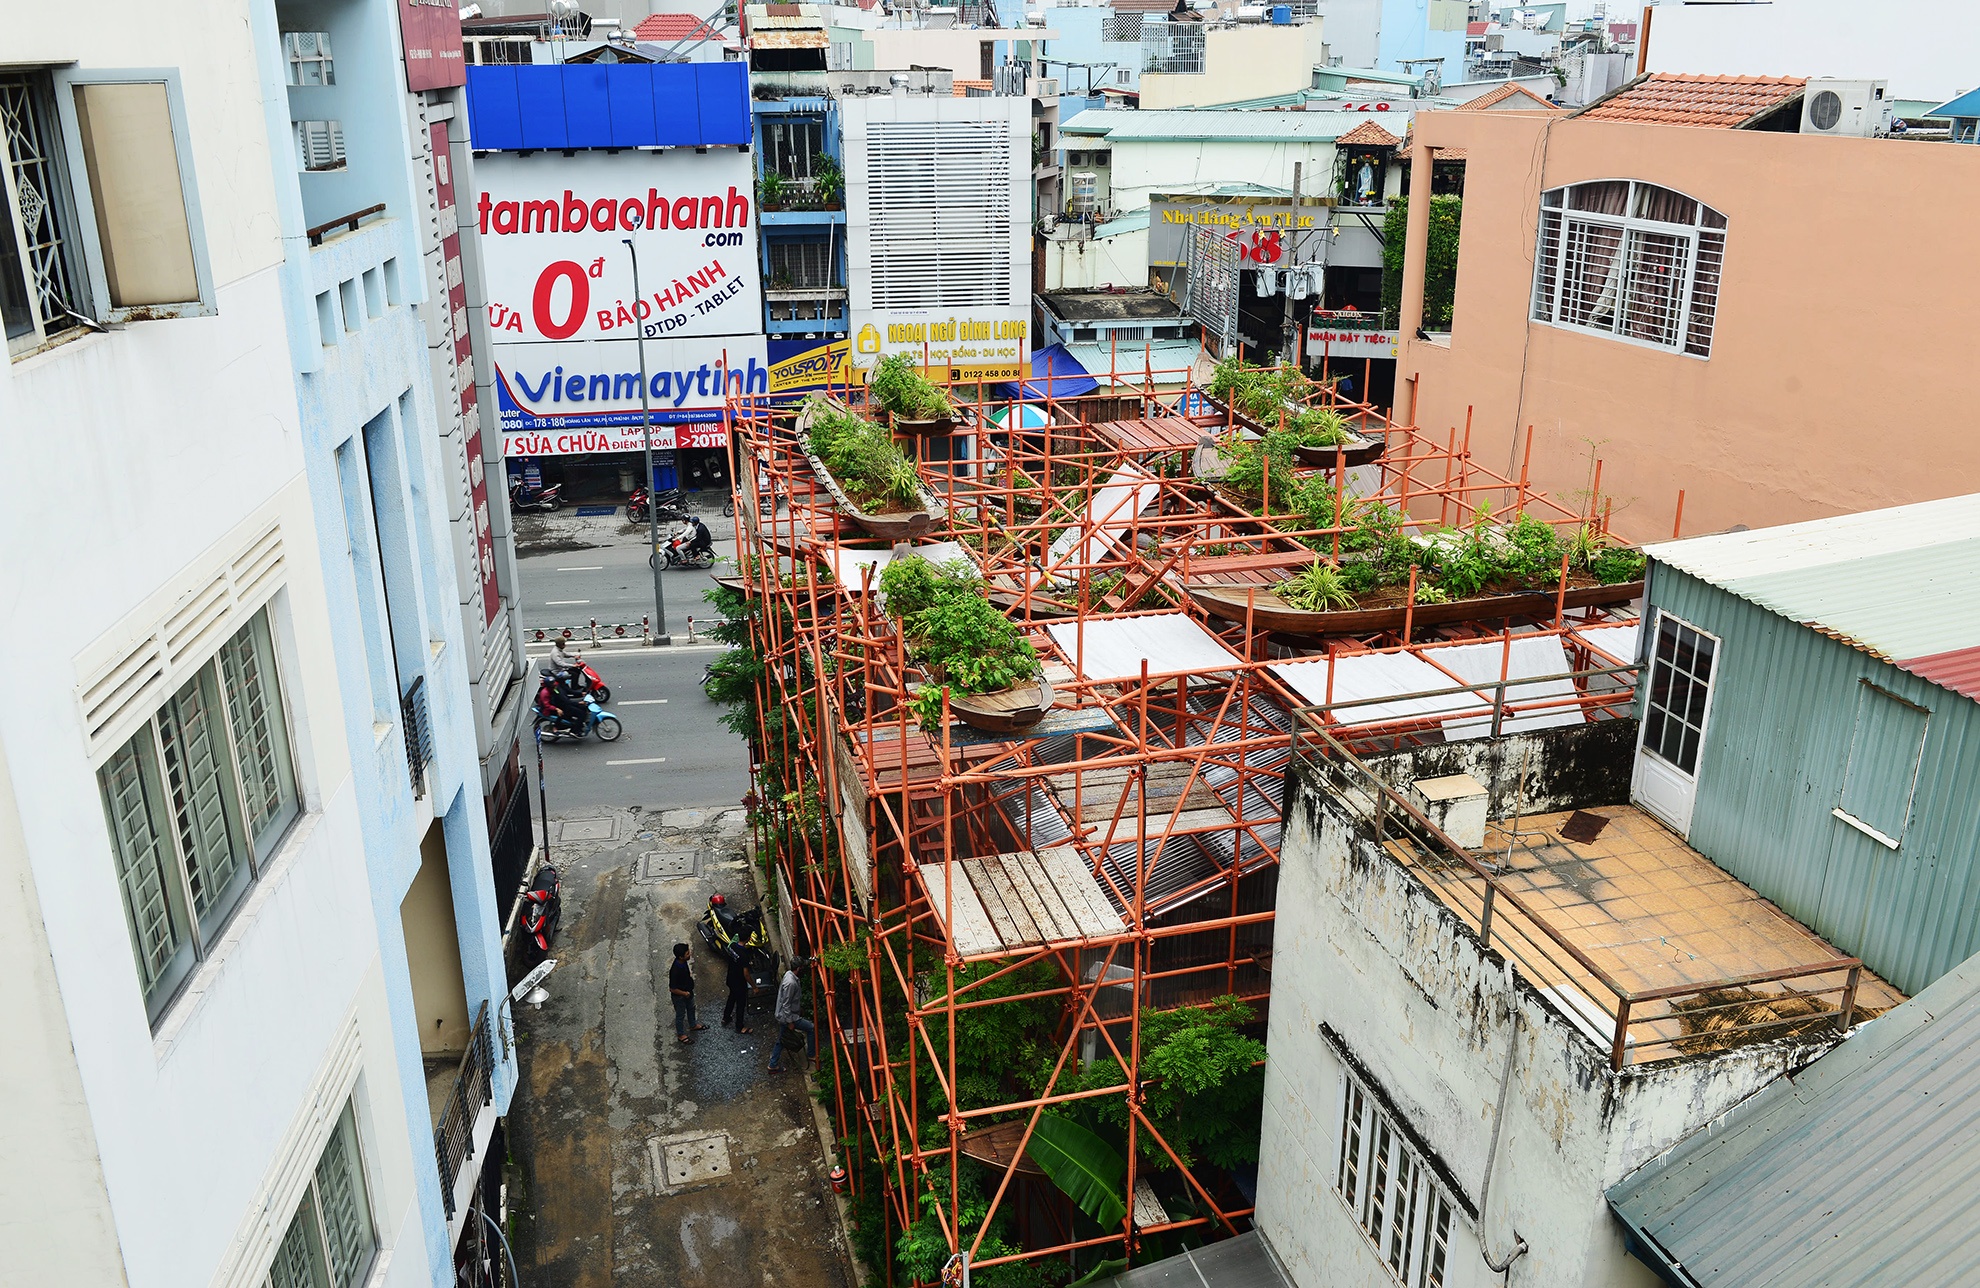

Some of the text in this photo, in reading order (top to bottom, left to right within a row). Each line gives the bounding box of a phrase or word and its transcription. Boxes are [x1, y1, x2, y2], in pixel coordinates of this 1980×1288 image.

[478, 186, 749, 235] tambaohanh
[701, 231, 743, 247] .com
[596, 259, 727, 331] BẢO HÀNH
[644, 313, 687, 338] ĐTDĐ
[695, 275, 745, 317] TABLET
[888, 317, 1026, 346] NGOẠI NGỮ ĐÌNH LONG
[930, 349, 949, 361] HỌC
[983, 348, 995, 357] DU
[997, 347, 1016, 359] HỌC
[963, 370, 983, 379] 0122
[985, 370, 999, 378] 458
[1001, 369, 1011, 377] 00
[514, 431, 553, 455] SỬA
[557, 430, 611, 453] CHỮA
[612, 440, 638, 452] ĐIỆN
